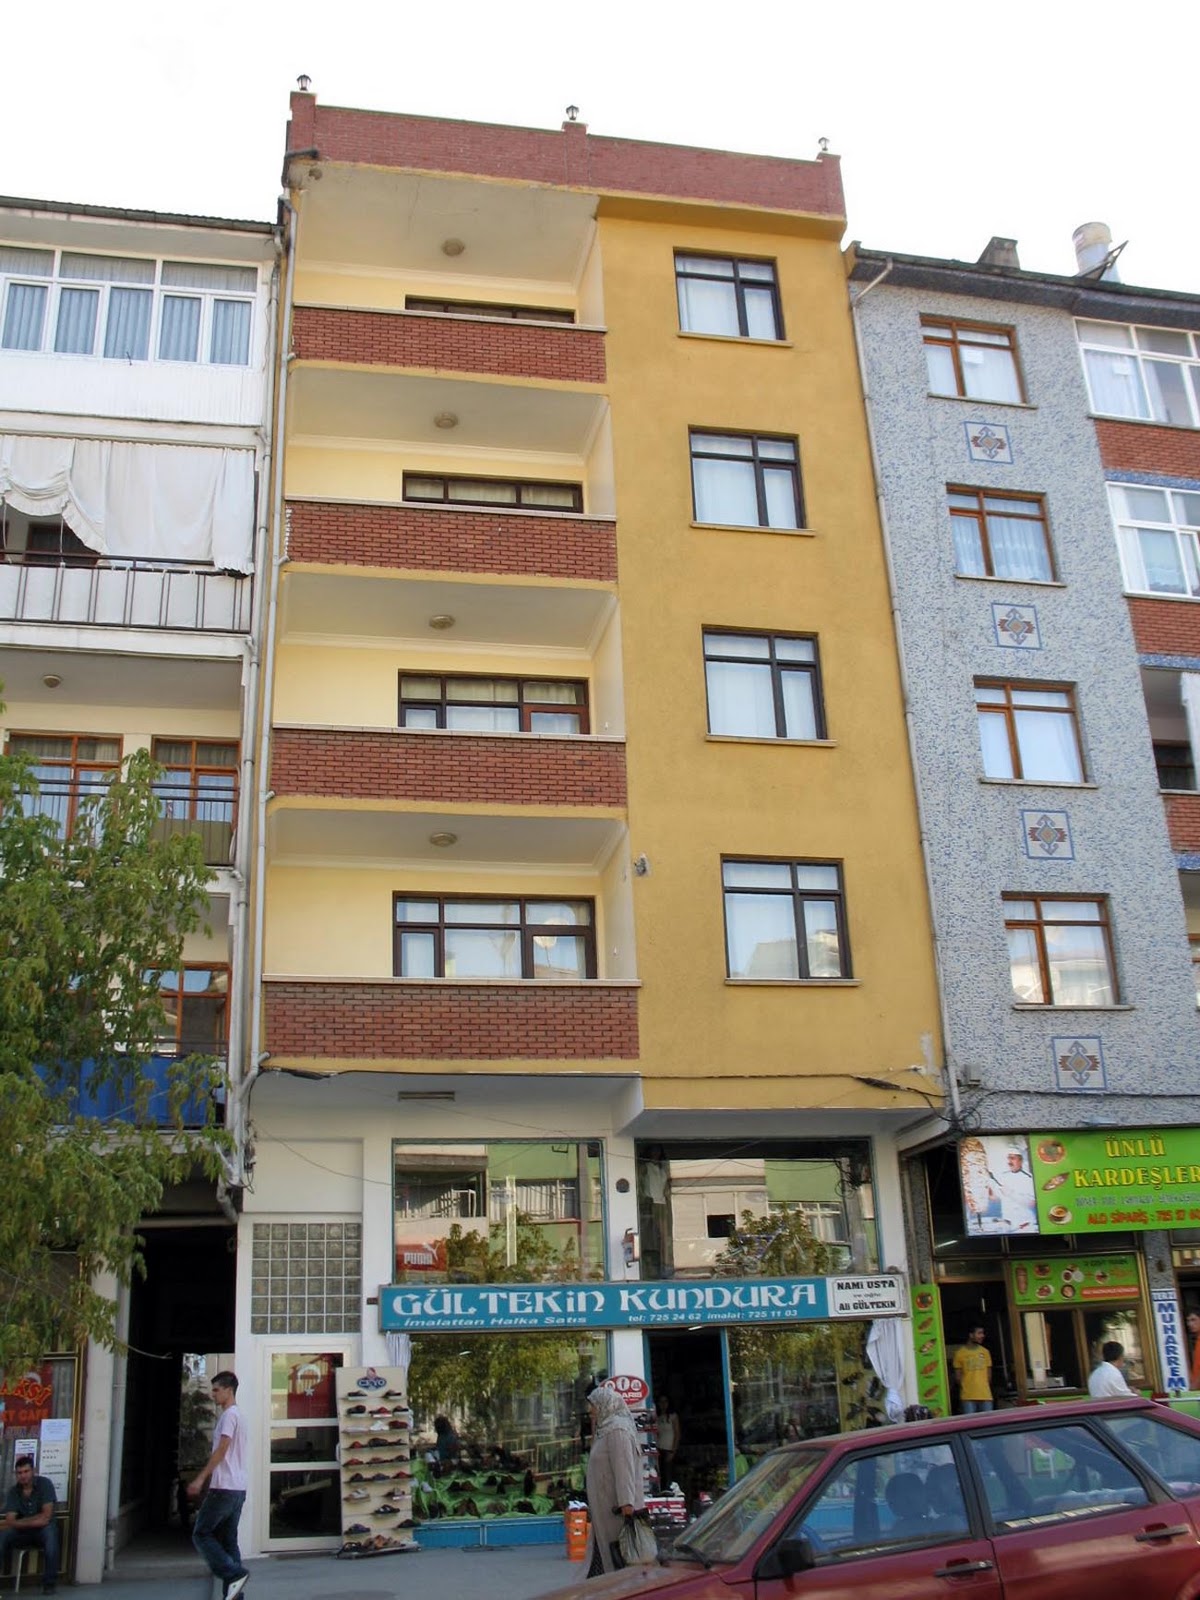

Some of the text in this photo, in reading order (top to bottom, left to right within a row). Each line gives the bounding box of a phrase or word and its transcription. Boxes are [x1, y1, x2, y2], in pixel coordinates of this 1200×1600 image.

[1105, 1132, 1166, 1158] ÜNLÜ
[1073, 1165, 1200, 1190] KARDEŞLER
[867, 1280, 895, 1289] USTA
[619, 1284, 817, 1311] KUNDURA
[490, 1317, 538, 1326] Halka
[785, 1309, 798, 1317] 03
[1157, 1302, 1187, 1388] MUHARREM
